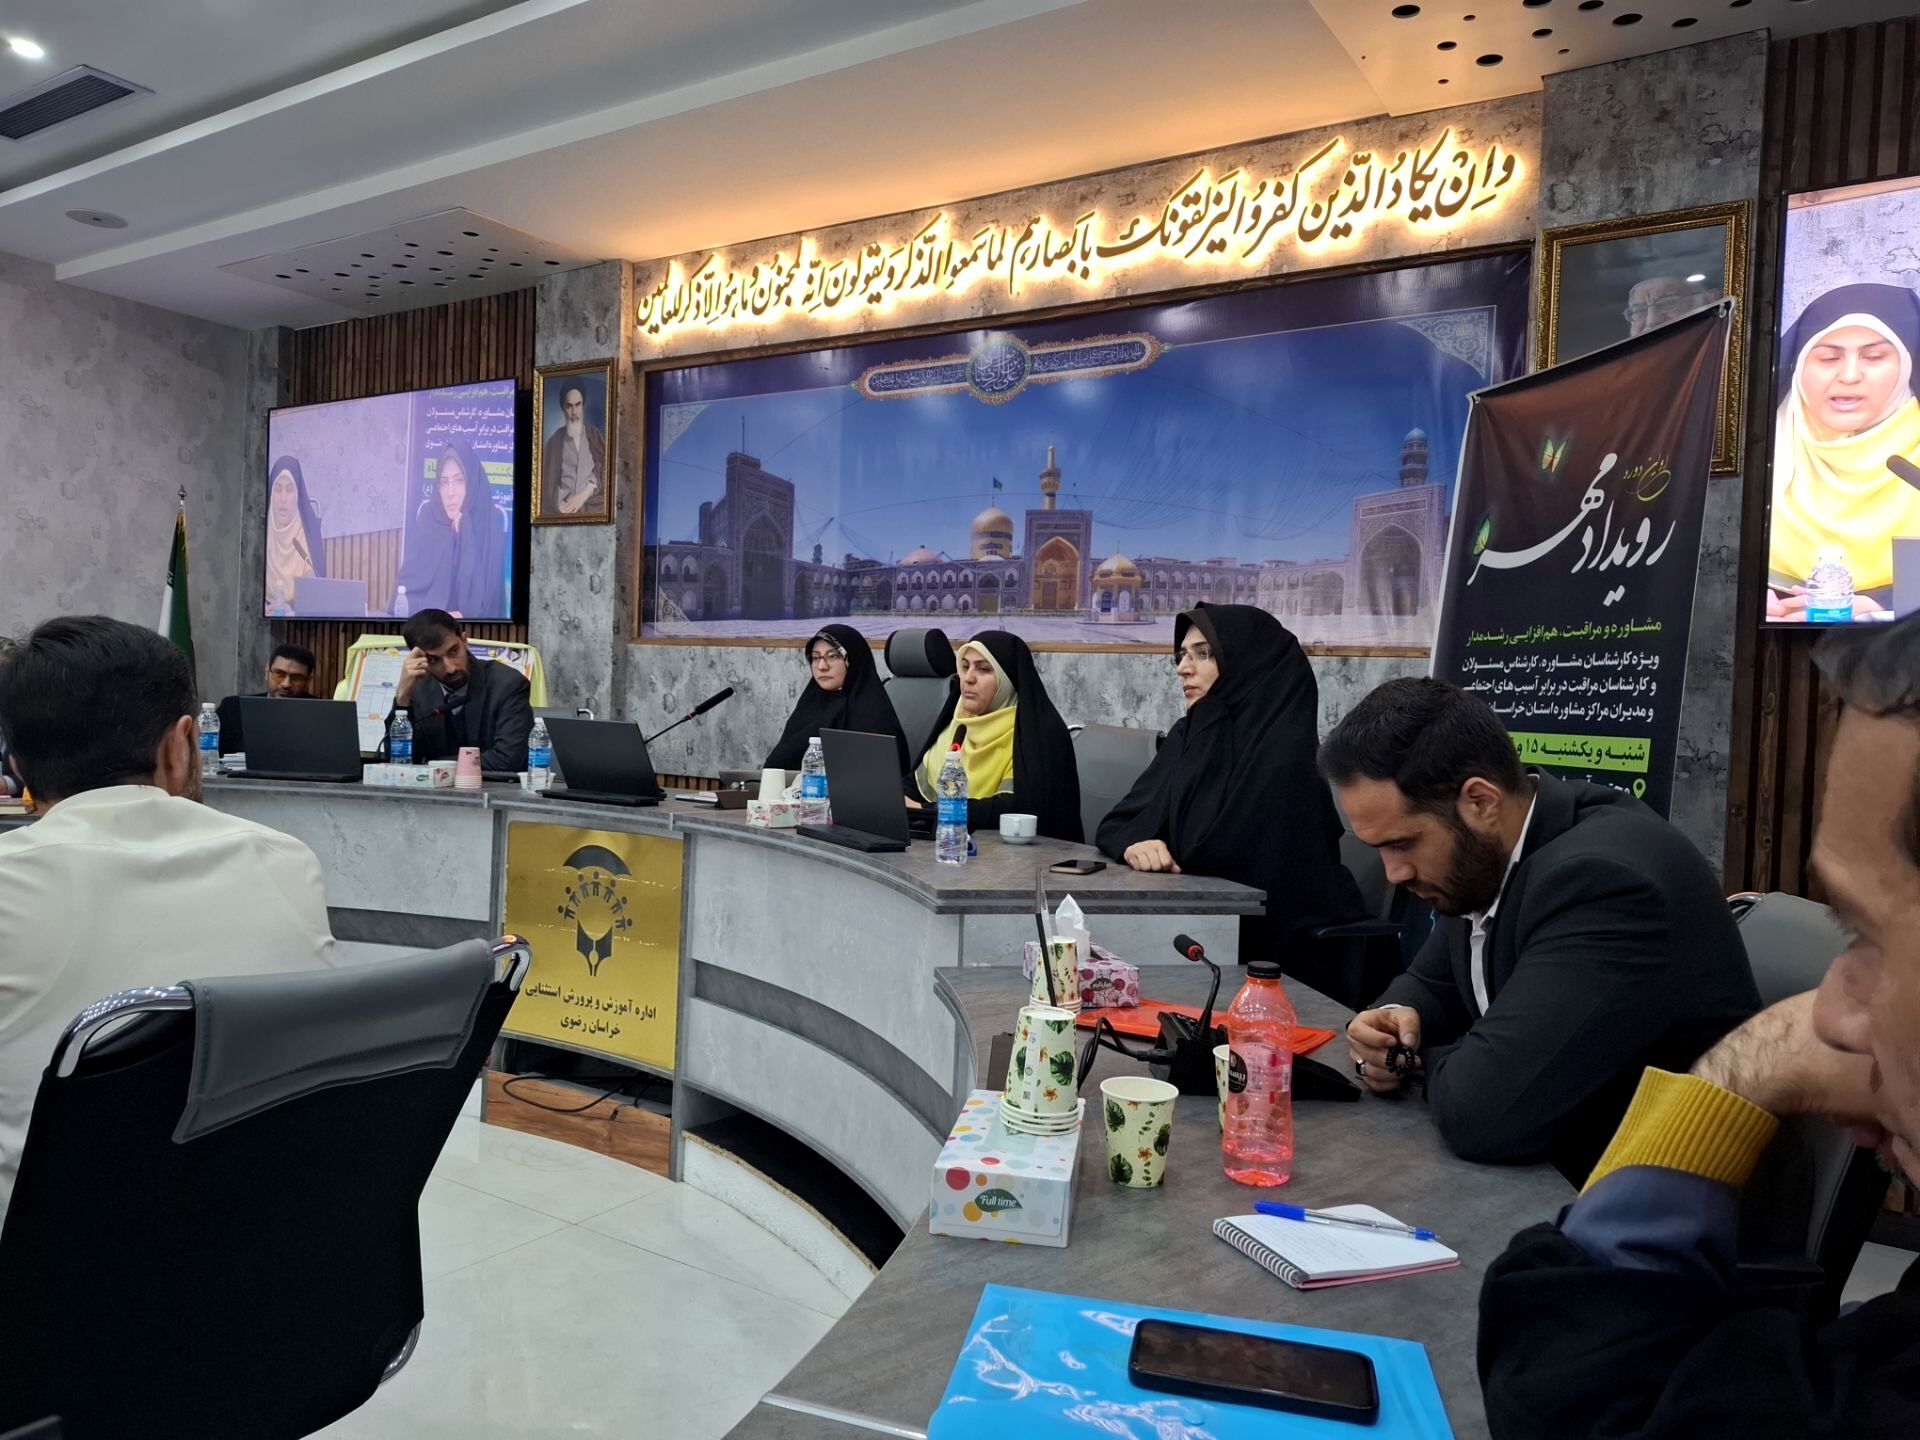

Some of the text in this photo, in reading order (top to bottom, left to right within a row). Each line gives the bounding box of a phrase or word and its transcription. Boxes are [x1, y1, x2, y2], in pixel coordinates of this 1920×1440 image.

[1466, 452, 1677, 607] رویداد مهر
[1603, 625, 1611, 640] و
[1611, 616, 1662, 639] مشاوره
[1504, 654, 1540, 674] کارشناس
[1583, 650, 1633, 671] کارشناسان
[1632, 651, 1660, 671] ویژه
[1537, 678, 1556, 697] برابر
[1555, 680, 1568, 697] در
[1568, 676, 1599, 697] مراقبت
[1599, 676, 1650, 697] کارشناسان
[1649, 681, 1657, 697] و
[1525, 701, 1555, 717] استان
[1553, 702, 1585, 720] مشاوره
[1584, 702, 1610, 722] مراکز
[1609, 702, 1647, 722] مدیران
[1646, 707, 1655, 722] و
[1526, 737, 1539, 754] ۱۵
[1540, 740, 1593, 763] یکشنبه
[1605, 743, 1646, 766] شنبه
[1594, 747, 1603, 765] و
[562, 987, 594, 1008] پرورش
[595, 998, 601, 1010] و
[601, 996, 633, 1015] آموزش
[634, 1004, 657, 1021] اداره
[560, 1014, 621, 1039] خراسان رضوی
[980, 1194, 1018, 1208] Full time
